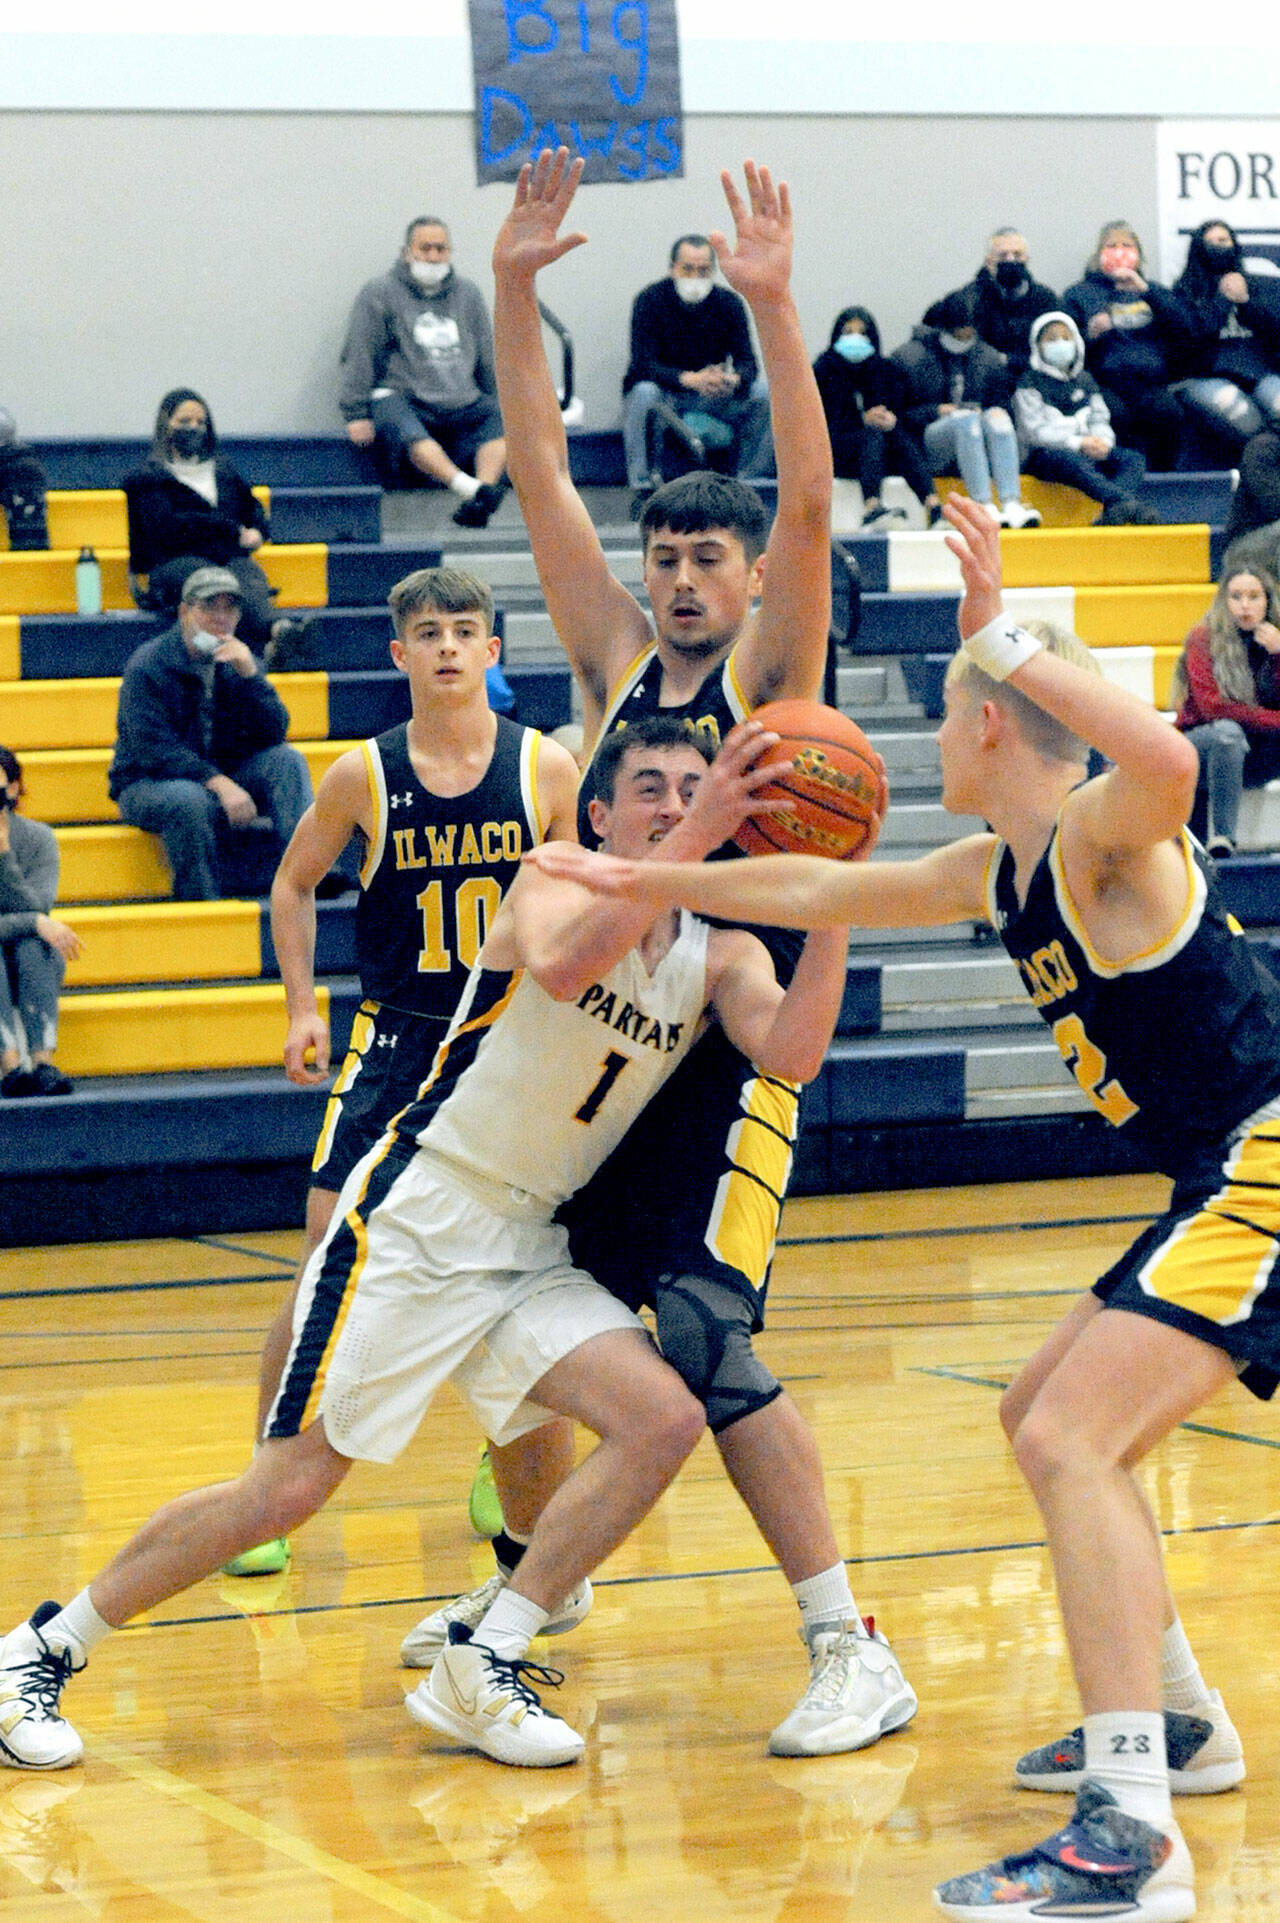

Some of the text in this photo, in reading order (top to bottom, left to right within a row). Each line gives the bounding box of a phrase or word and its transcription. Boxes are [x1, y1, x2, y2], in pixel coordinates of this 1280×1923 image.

[393, 821, 522, 870] ILWACO
[416, 876, 502, 973] 10
[572, 1047, 631, 1125] 1
[1111, 1734, 1151, 1754] 23
